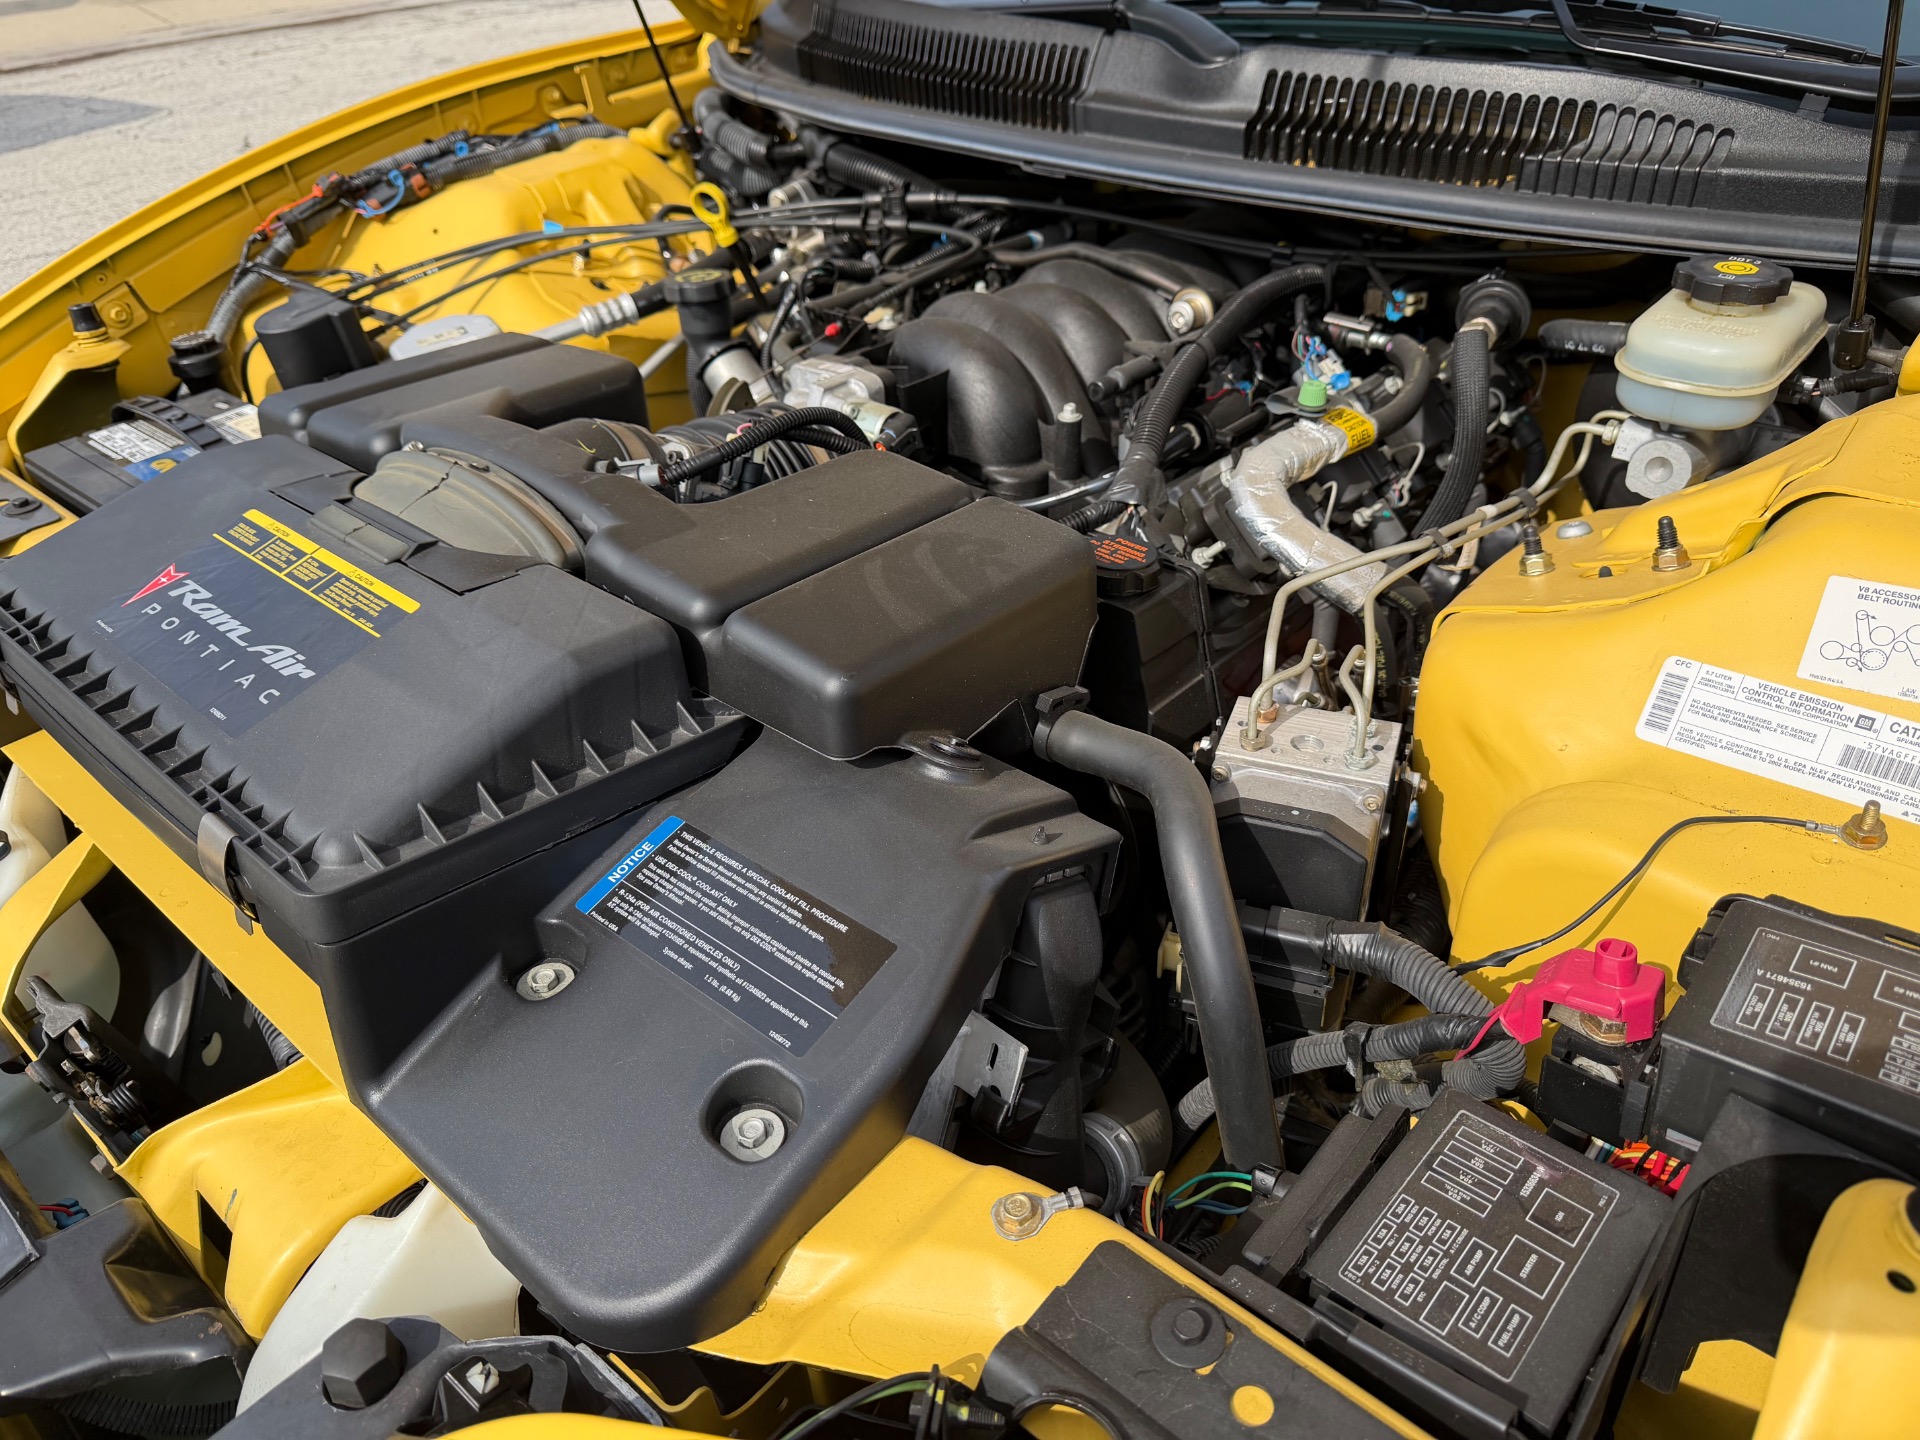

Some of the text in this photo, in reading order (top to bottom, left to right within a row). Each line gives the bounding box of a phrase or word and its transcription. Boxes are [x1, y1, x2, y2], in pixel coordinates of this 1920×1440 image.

[1728, 255, 1753, 263] DOT
[1351, 428, 1371, 443] FUEL
[1102, 539, 1146, 558] STEERING
[1115, 537, 1149, 552] POWER
[353, 573, 376, 587] CAUTION
[1858, 585, 1869, 593] V8
[1857, 593, 1881, 602] BELT
[167, 579, 316, 680] Ram Air
[140, 602, 281, 705] PONTIAC
[1674, 658, 1692, 668] CFC
[1714, 672, 1732, 681] LITER
[1757, 682, 1843, 712] VEHICLE EMISSION
[1901, 686, 1916, 695] LAW
[1741, 686, 1854, 723] CONTROL INFORMATION
[1744, 695, 1848, 728] GENERAL MOTORS CORPORATION
[1687, 707, 1700, 715] FOR
[1700, 711, 1718, 721] MORE
[1701, 701, 1745, 718] ADJUSTMENTS
[1776, 722, 1788, 731] SEE
[1789, 726, 1817, 739] SERVICE
[1689, 703, 1815, 744] MANUAL AND MAINTENANCE SCHEDULE
[1676, 730, 1717, 747] REGULATIONS
[1719, 742, 1756, 759] APPLICABLE
[1767, 759, 1782, 767] 2002
[1783, 763, 1825, 780] MODEL-YEAR
[1826, 776, 1841, 785] NEW
[1843, 782, 1856, 790] LEV
[1857, 786, 1898, 803] PASSENGER
[1679, 725, 1693, 734] THIS
[1696, 731, 1723, 743] VEHICLE
[1725, 740, 1762, 755] CONFORMS
[1793, 760, 1806, 769] EPA
[1809, 765, 1828, 776] NLEV
[1831, 772, 1881, 793] REGULATIONS
[1884, 788, 1900, 799] AND
[607, 841, 655, 882] NOTICE
[654, 854, 667, 864] USE
[695, 879, 723, 898] COOLANT
[720, 895, 738, 907] ONLY
[680, 830, 694, 841] THIS
[692, 837, 716, 854] VEHICLE
[714, 850, 743, 870] REQUIRES
[746, 869, 771, 887] SPECIAL
[769, 883, 799, 903] COOLANT
[796, 899, 811, 911] FILL
[810, 907, 848, 932] PROCEDURE
[589, 910, 606, 922] Printed
[607, 922, 618, 931] USA
[617, 888, 740, 971] R-134a (FOR AIR CONDITIONED VEHICLES ONLY)
[662, 946, 694, 970] System charge:
[1820, 962, 1838, 972] FAN
[1480, 1143, 1494, 1153] 40A
[1458, 1174, 1472, 1184] 40A
[1394, 1202, 1406, 1214] 20A
[1403, 1212, 1413, 1223] ENG
[1417, 1215, 1429, 1226] 15A
[1433, 1218, 1442, 1227] IGN
[1554, 1210, 1565, 1222] IGN
[1376, 1227, 1388, 1239] 15A
[1441, 1228, 1452, 1240] 15A
[1399, 1241, 1411, 1253] 10A
[1408, 1244, 1423, 1263] ABS IGN
[1356, 1254, 1369, 1266] 15A
[1422, 1255, 1434, 1267] 15A
[1463, 1248, 1484, 1275] AIR PUMP
[1519, 1253, 1538, 1278] STARTER
[1380, 1268, 1392, 1280] 15A
[1431, 1257, 1449, 1279] ENG CTRL
[1390, 1273, 1404, 1289] STRTR
[1403, 1282, 1415, 1295] 10A
[1416, 1291, 1426, 1302] ETC
[1476, 1295, 1491, 1314] COMP
[1497, 1312, 1521, 1347] FUEL PUMP
